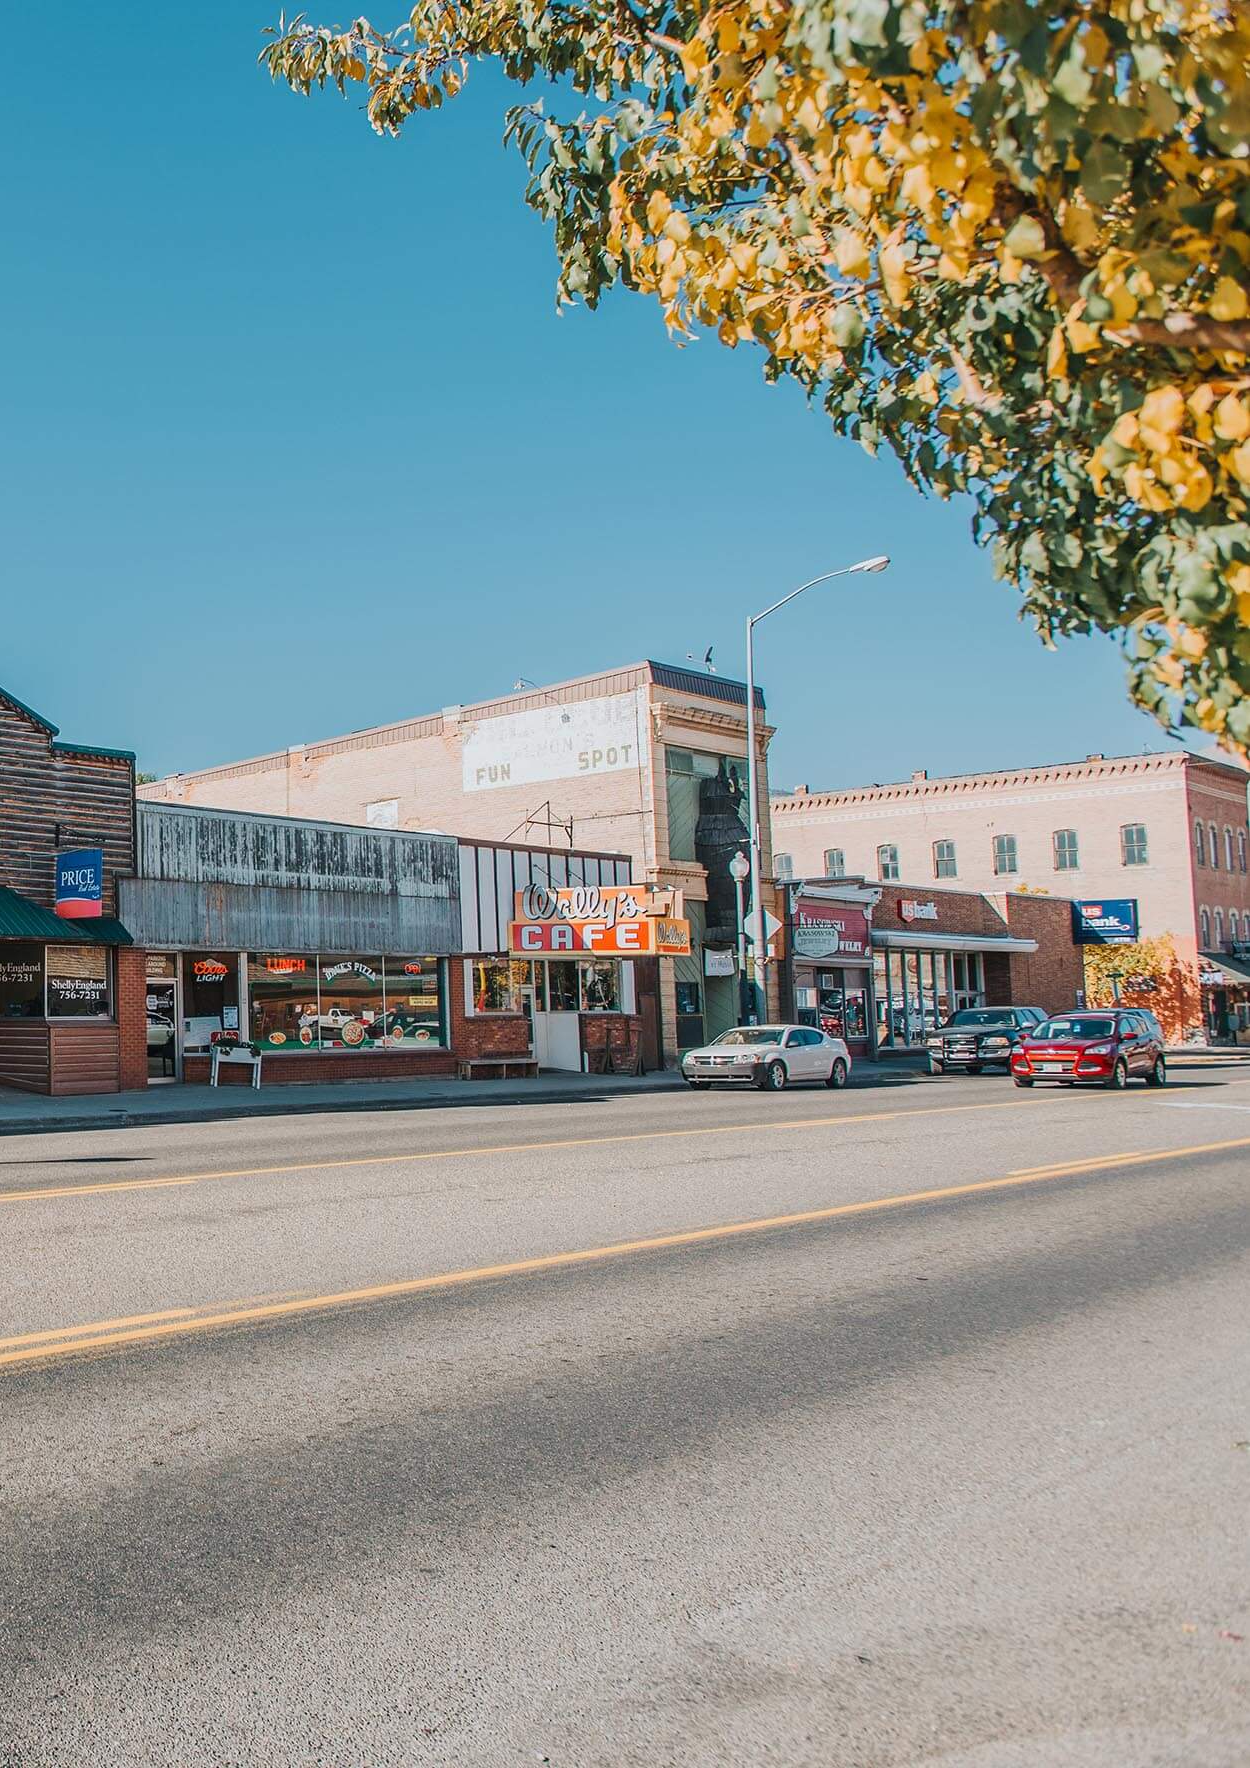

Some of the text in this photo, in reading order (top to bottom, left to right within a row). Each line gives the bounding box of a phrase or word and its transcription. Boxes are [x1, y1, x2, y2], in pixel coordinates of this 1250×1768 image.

[476, 744, 632, 785] FUN SPOT
[61, 868, 95, 887] PRICE
[523, 883, 648, 929] Wally's
[1081, 916, 1122, 927] bank
[521, 924, 640, 950] CAFE
[266, 958, 306, 971] LUNCH
[354, 962, 376, 981] PIZZA
[196, 974, 226, 982] LIGHT
[59, 990, 100, 999] 756-7231
